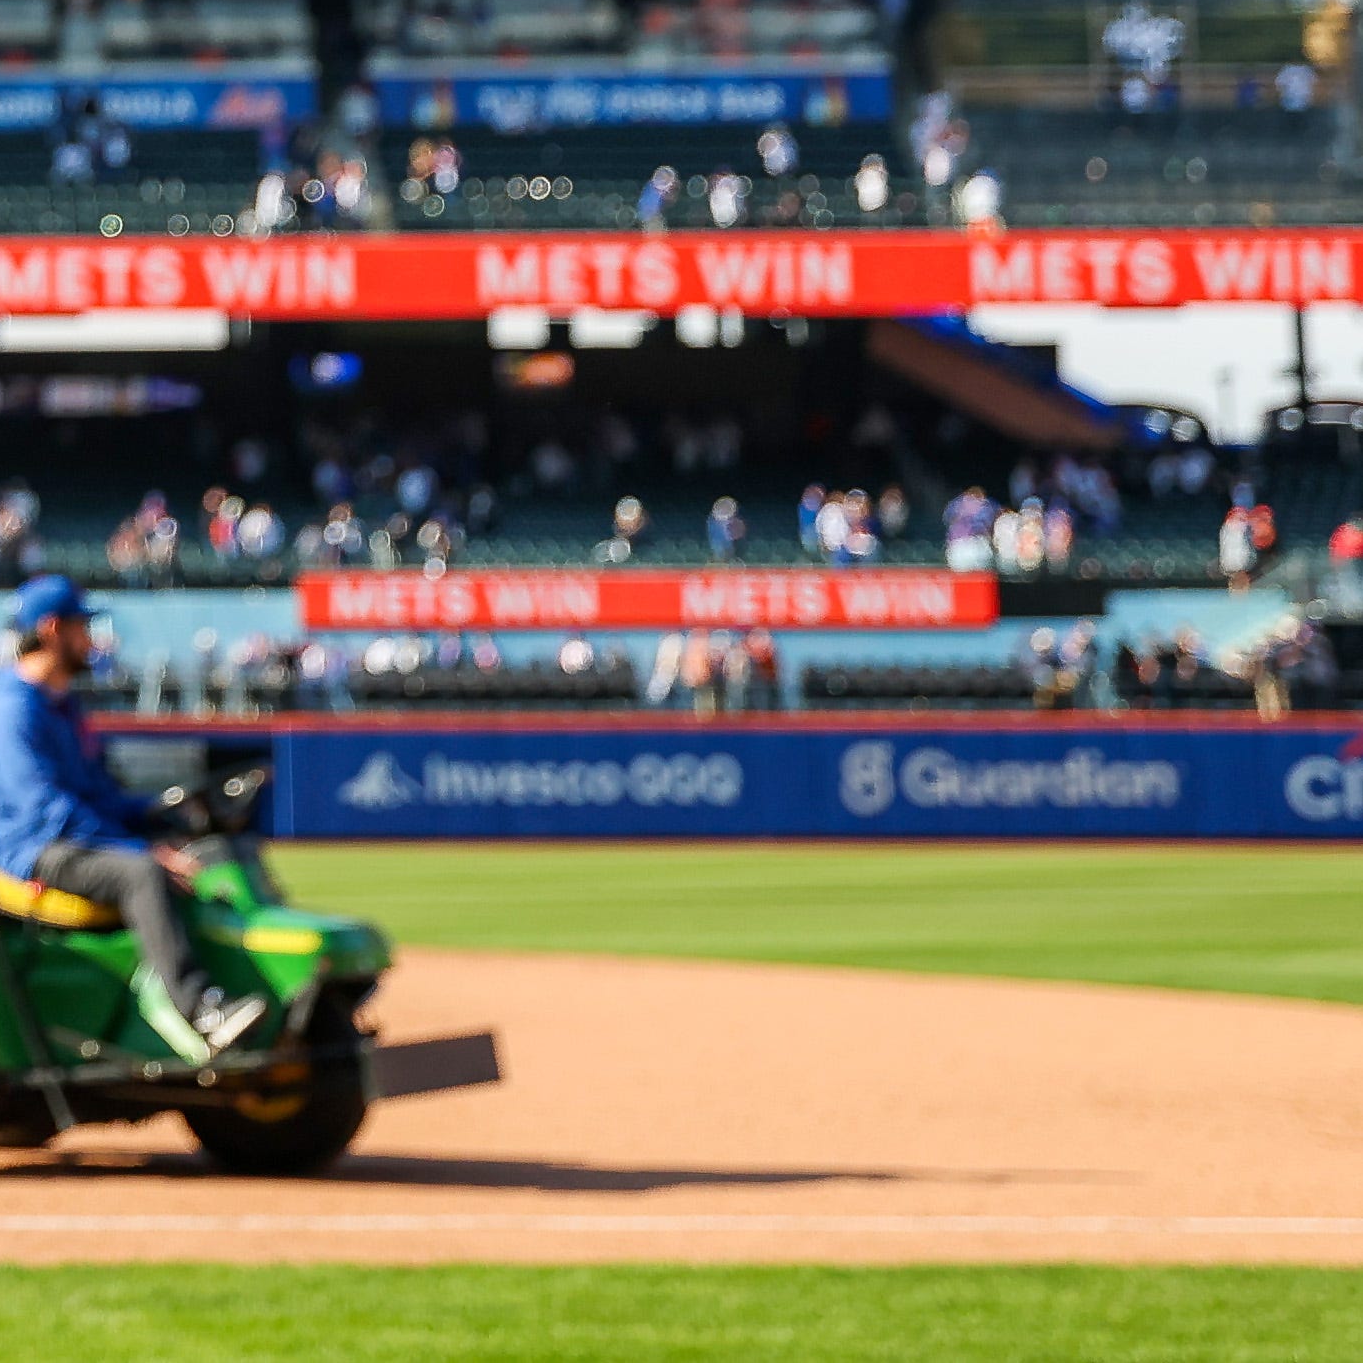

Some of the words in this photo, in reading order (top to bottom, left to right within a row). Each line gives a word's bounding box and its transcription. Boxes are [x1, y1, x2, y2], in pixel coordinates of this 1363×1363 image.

[204, 246, 357, 309] WIN
[477, 244, 675, 307] METS
[695, 242, 852, 305] WIN
[972, 240, 1176, 304] METS
[1192, 238, 1350, 302] WIN
[329, 575, 477, 624] METS
[483, 575, 599, 624] WIN
[680, 575, 830, 624] METS
[840, 575, 955, 624] WIN
[900, 746, 1182, 808] Guardian
